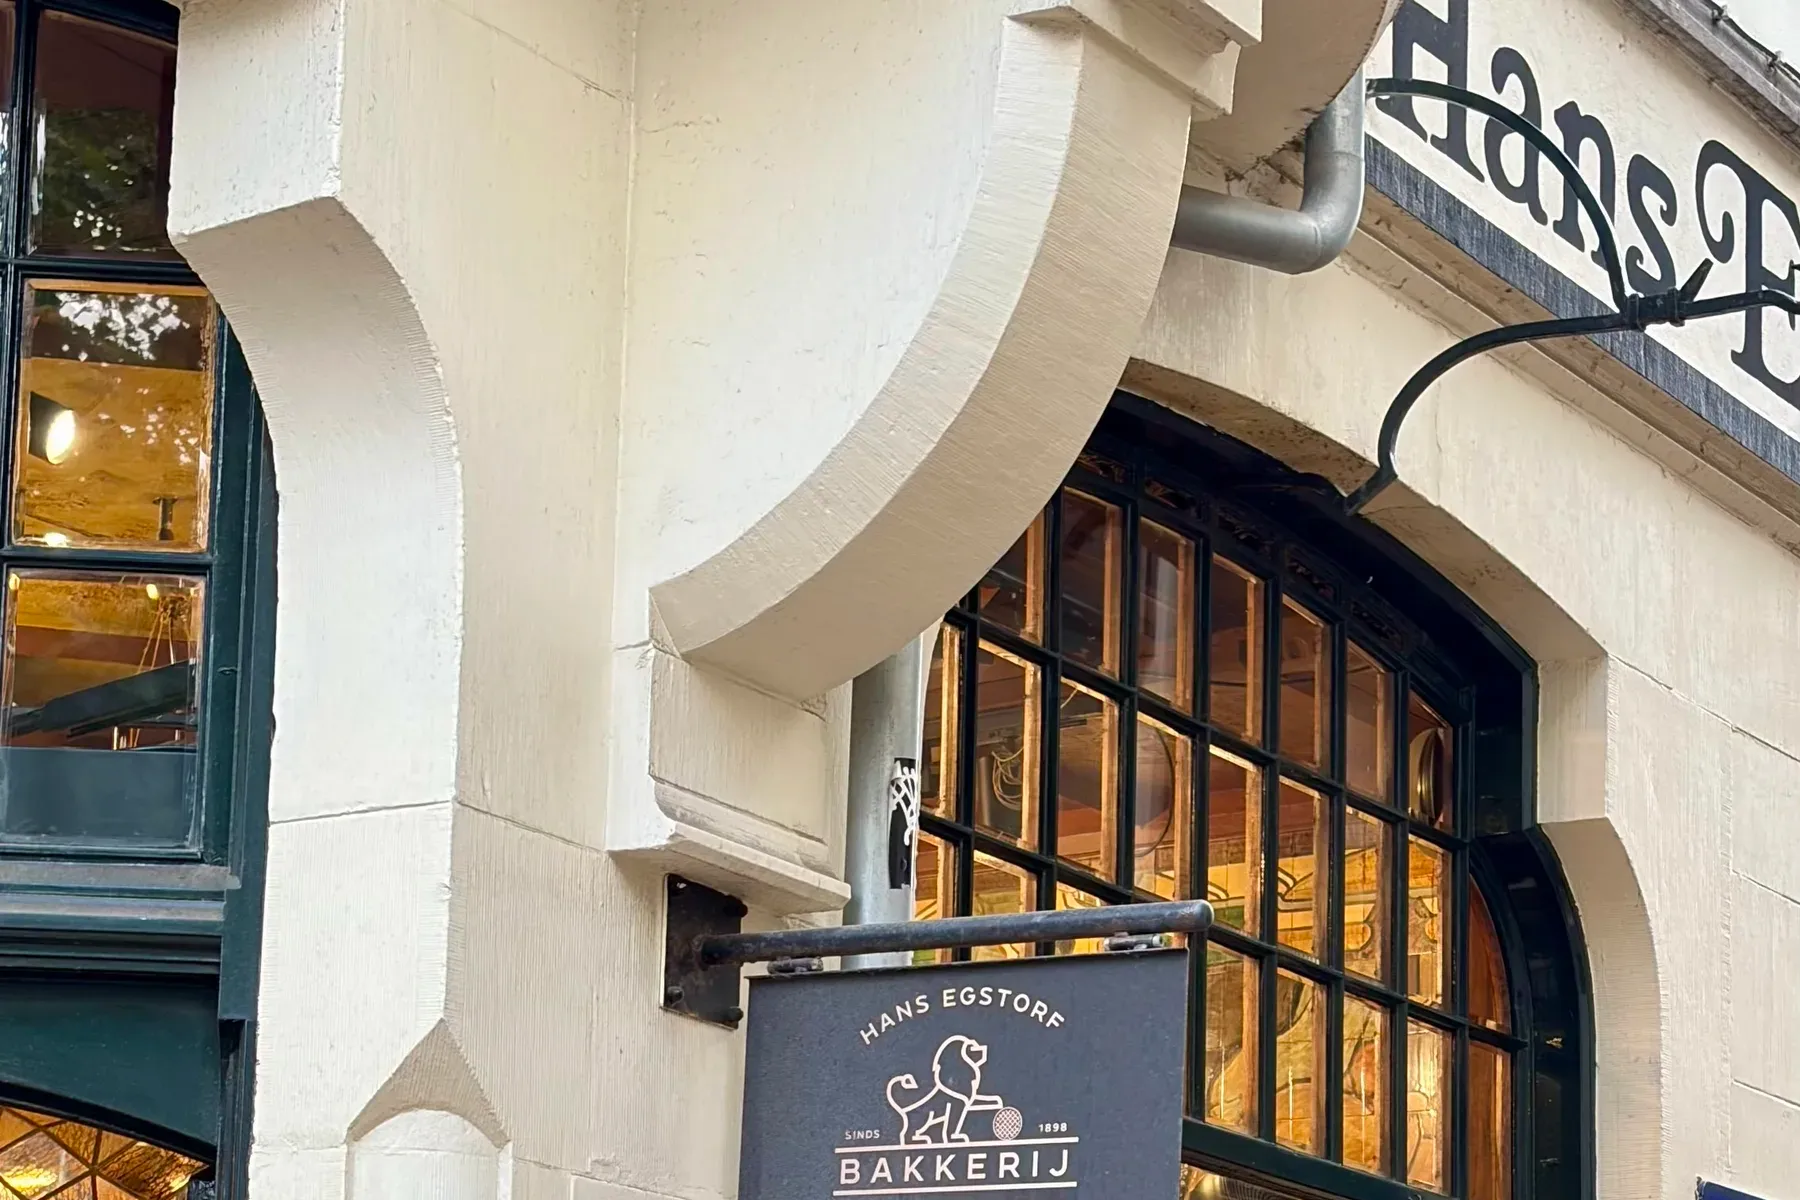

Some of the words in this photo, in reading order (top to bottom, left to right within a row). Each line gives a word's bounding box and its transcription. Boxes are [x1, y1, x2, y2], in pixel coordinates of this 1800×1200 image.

[1376, 0, 1678, 300] Hans
[859, 994, 930, 1045] HANS
[943, 986, 1066, 1030] EGSTORF
[844, 1129, 881, 1141] SINDS
[1038, 1122, 1068, 1133] 1898
[839, 1149, 1069, 1185] BAKKERIJ
